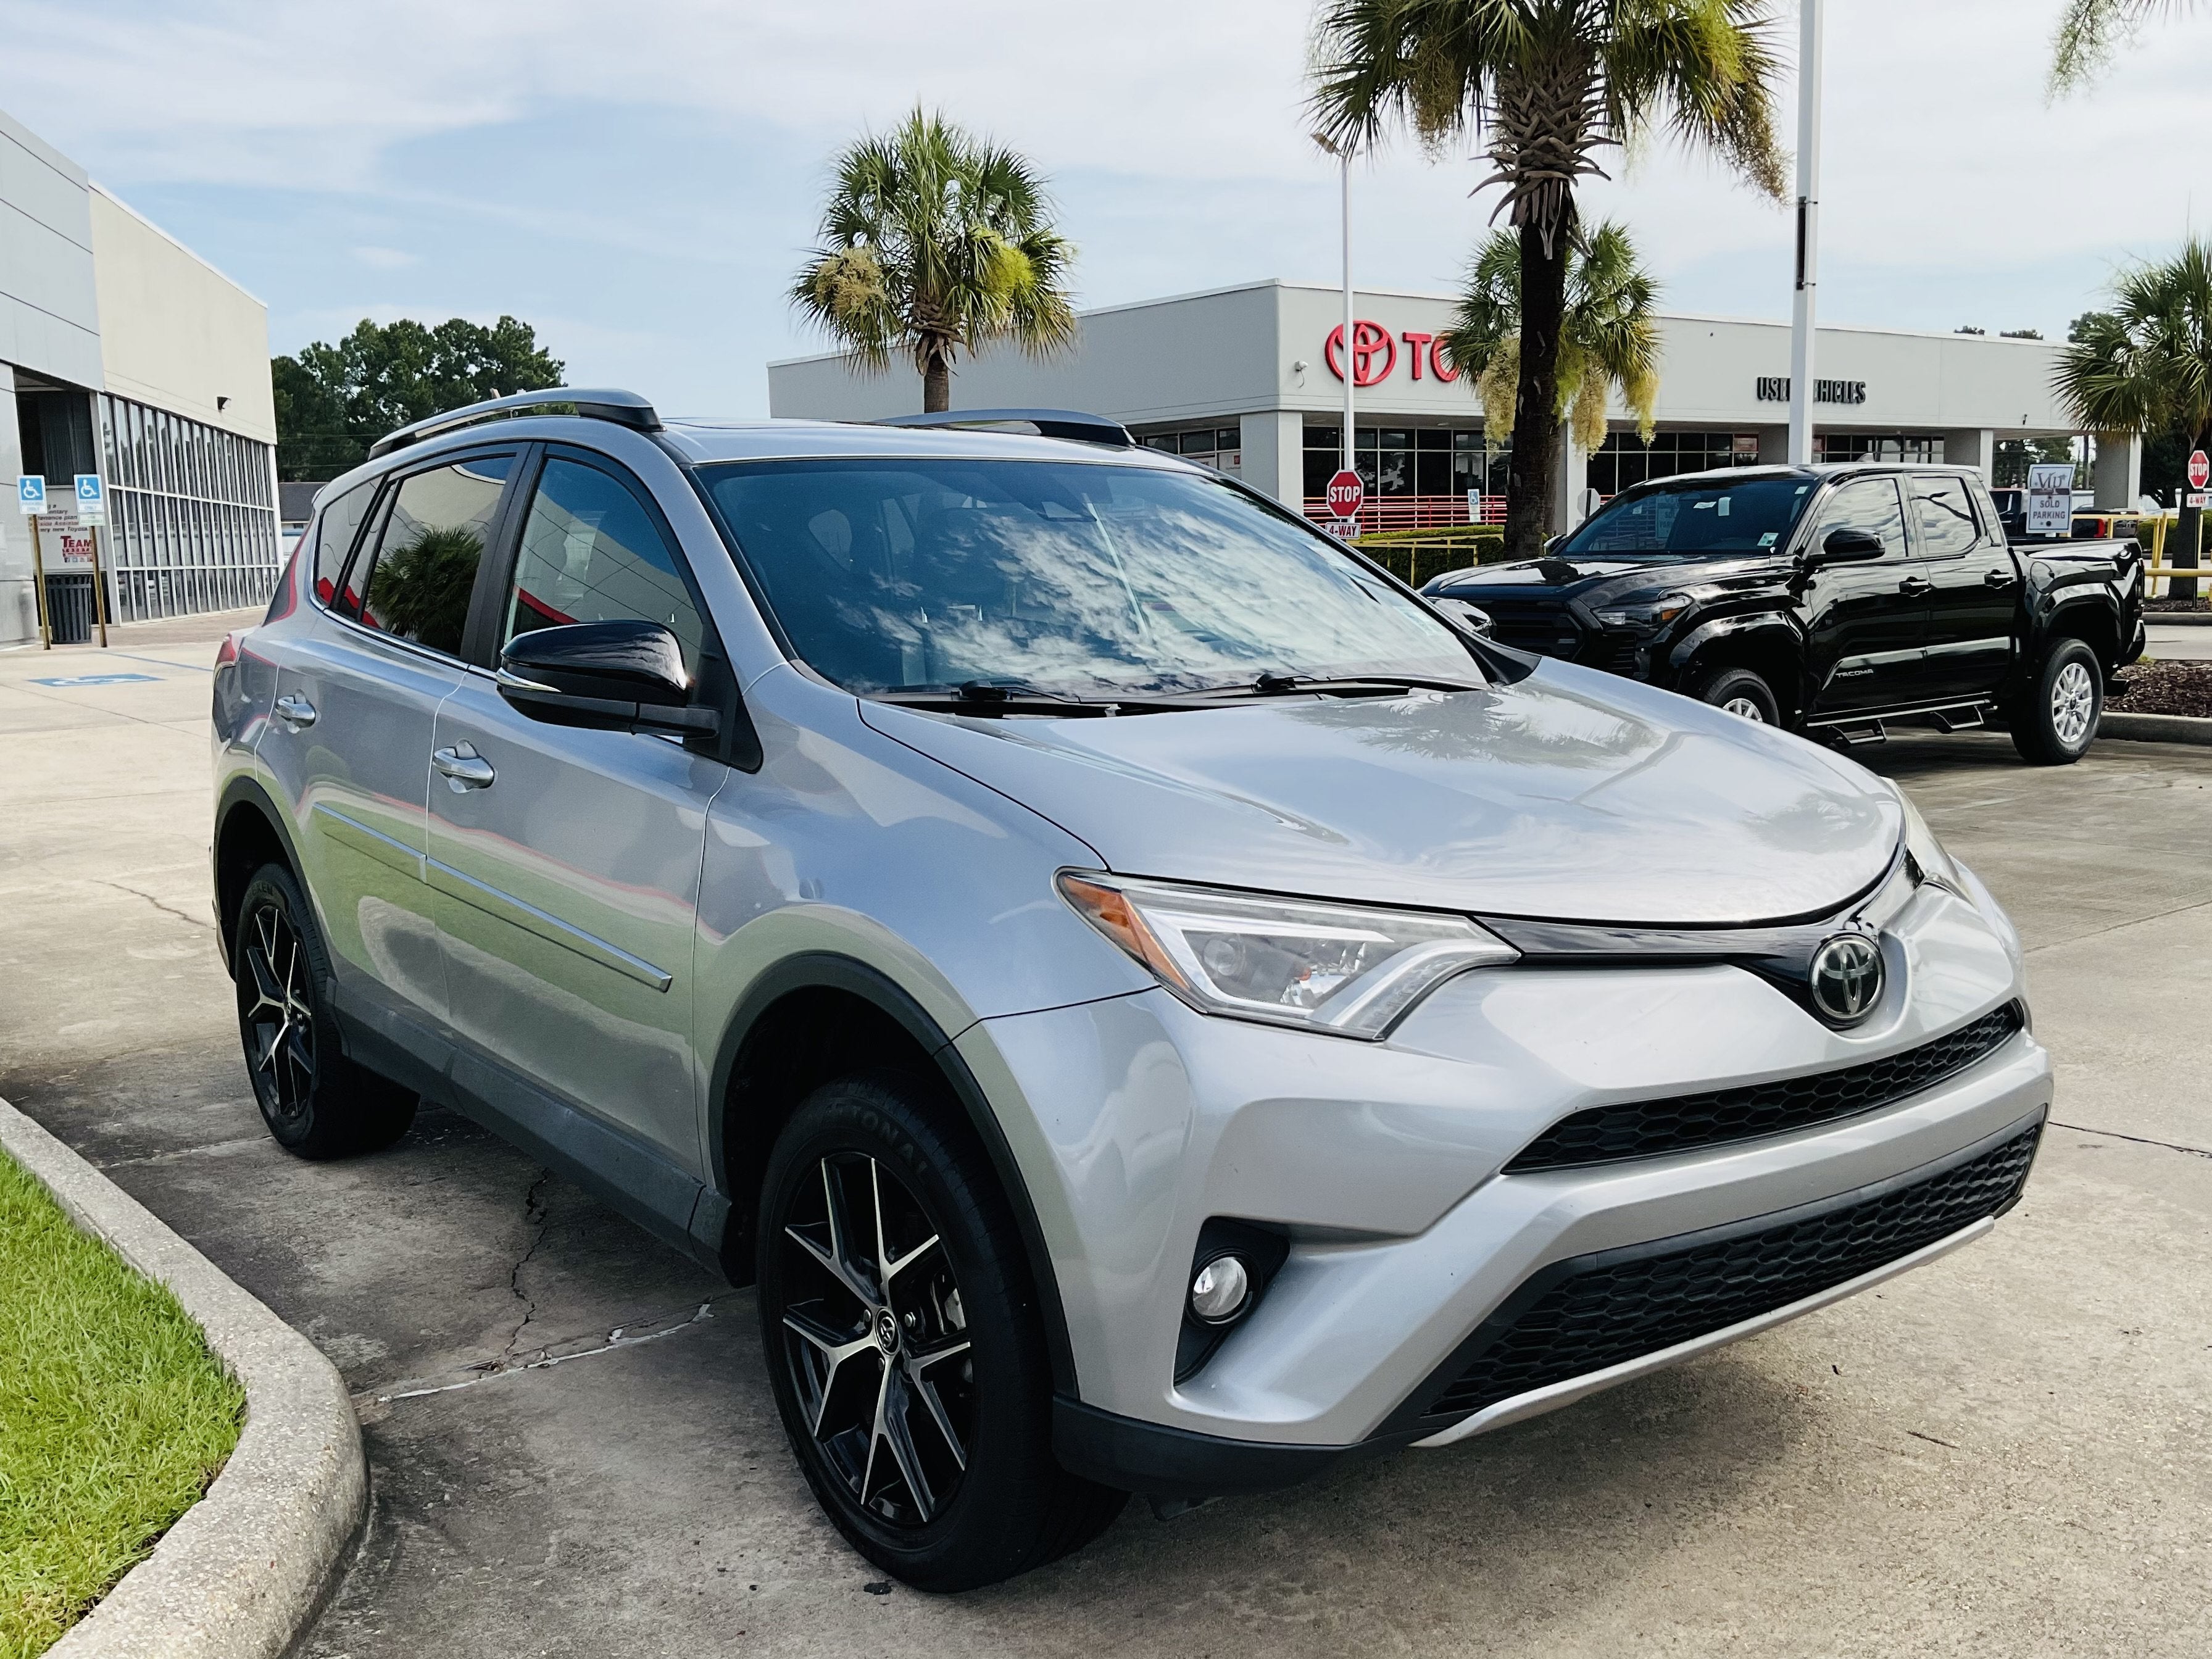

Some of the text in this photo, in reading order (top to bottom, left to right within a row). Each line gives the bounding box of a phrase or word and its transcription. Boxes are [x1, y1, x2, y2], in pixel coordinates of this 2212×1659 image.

[1757, 376, 1866, 404] USE EHICLES
[2190, 463, 2207, 476] STOP
[1329, 486, 1360, 502] STOP
[2039, 500, 2060, 508] SOLD
[2189, 496, 2206, 504] 4-WAY
[2032, 511, 2066, 519] PARKING
[1329, 525, 1357, 536] 4-WAY
[1835, 668, 1874, 678] TACOMA
